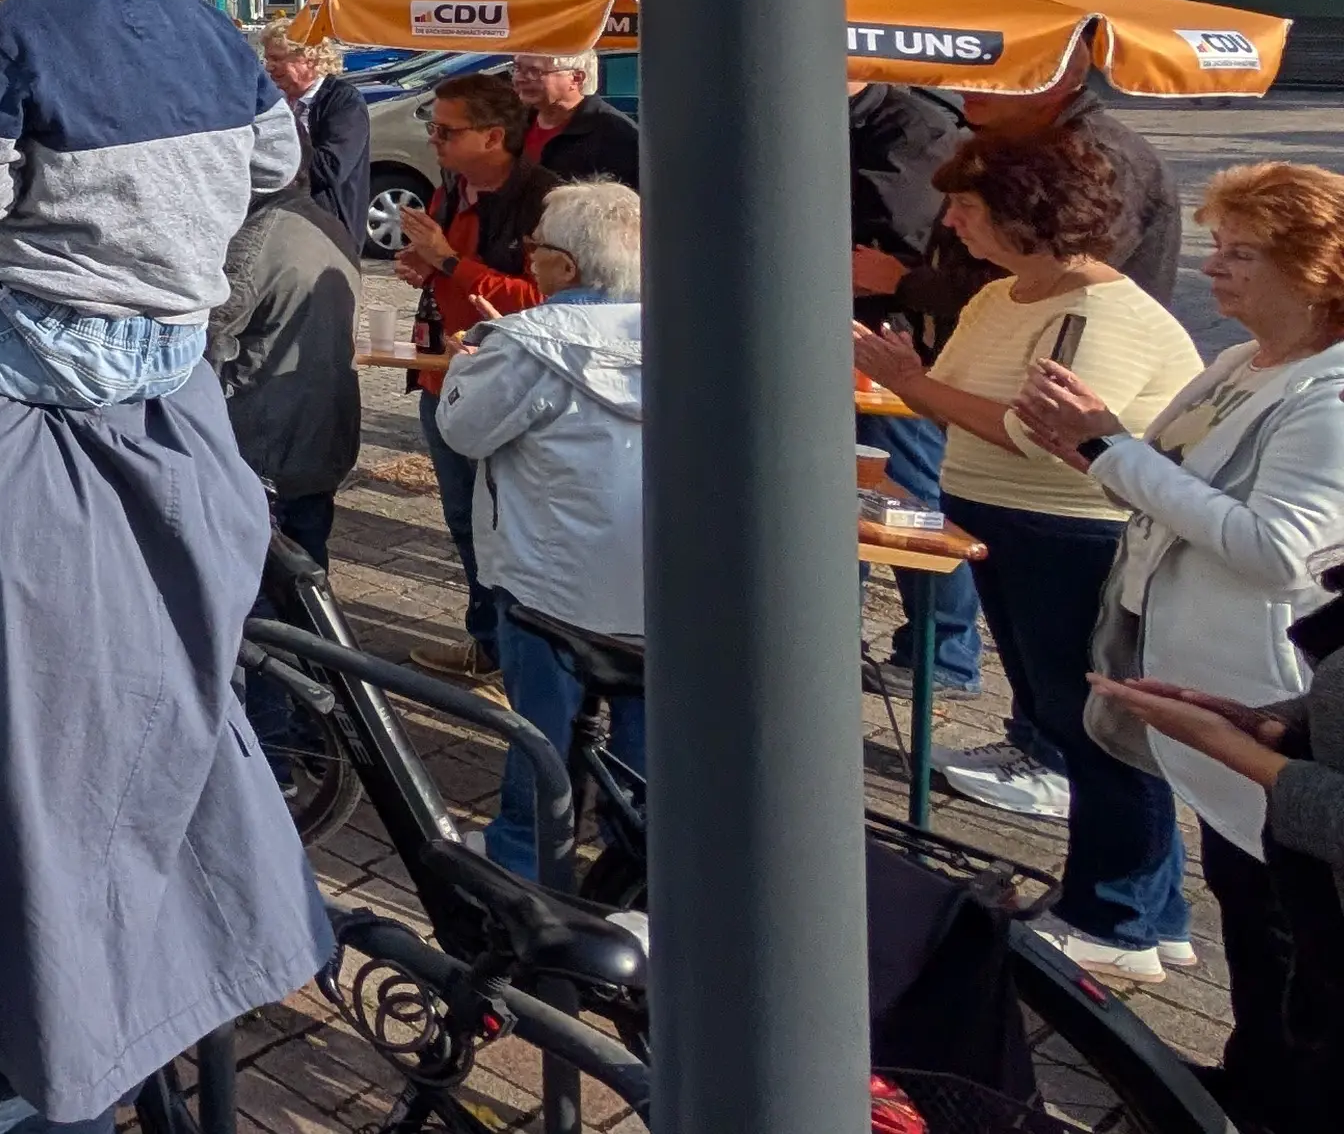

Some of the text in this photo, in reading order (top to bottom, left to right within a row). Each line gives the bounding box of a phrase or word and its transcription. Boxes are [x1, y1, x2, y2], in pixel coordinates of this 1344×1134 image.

[434, 4, 503, 24] CDU
[847, 27, 884, 51] IT
[895, 30, 992, 60] UNS.
[1201, 33, 1253, 53] CDU
